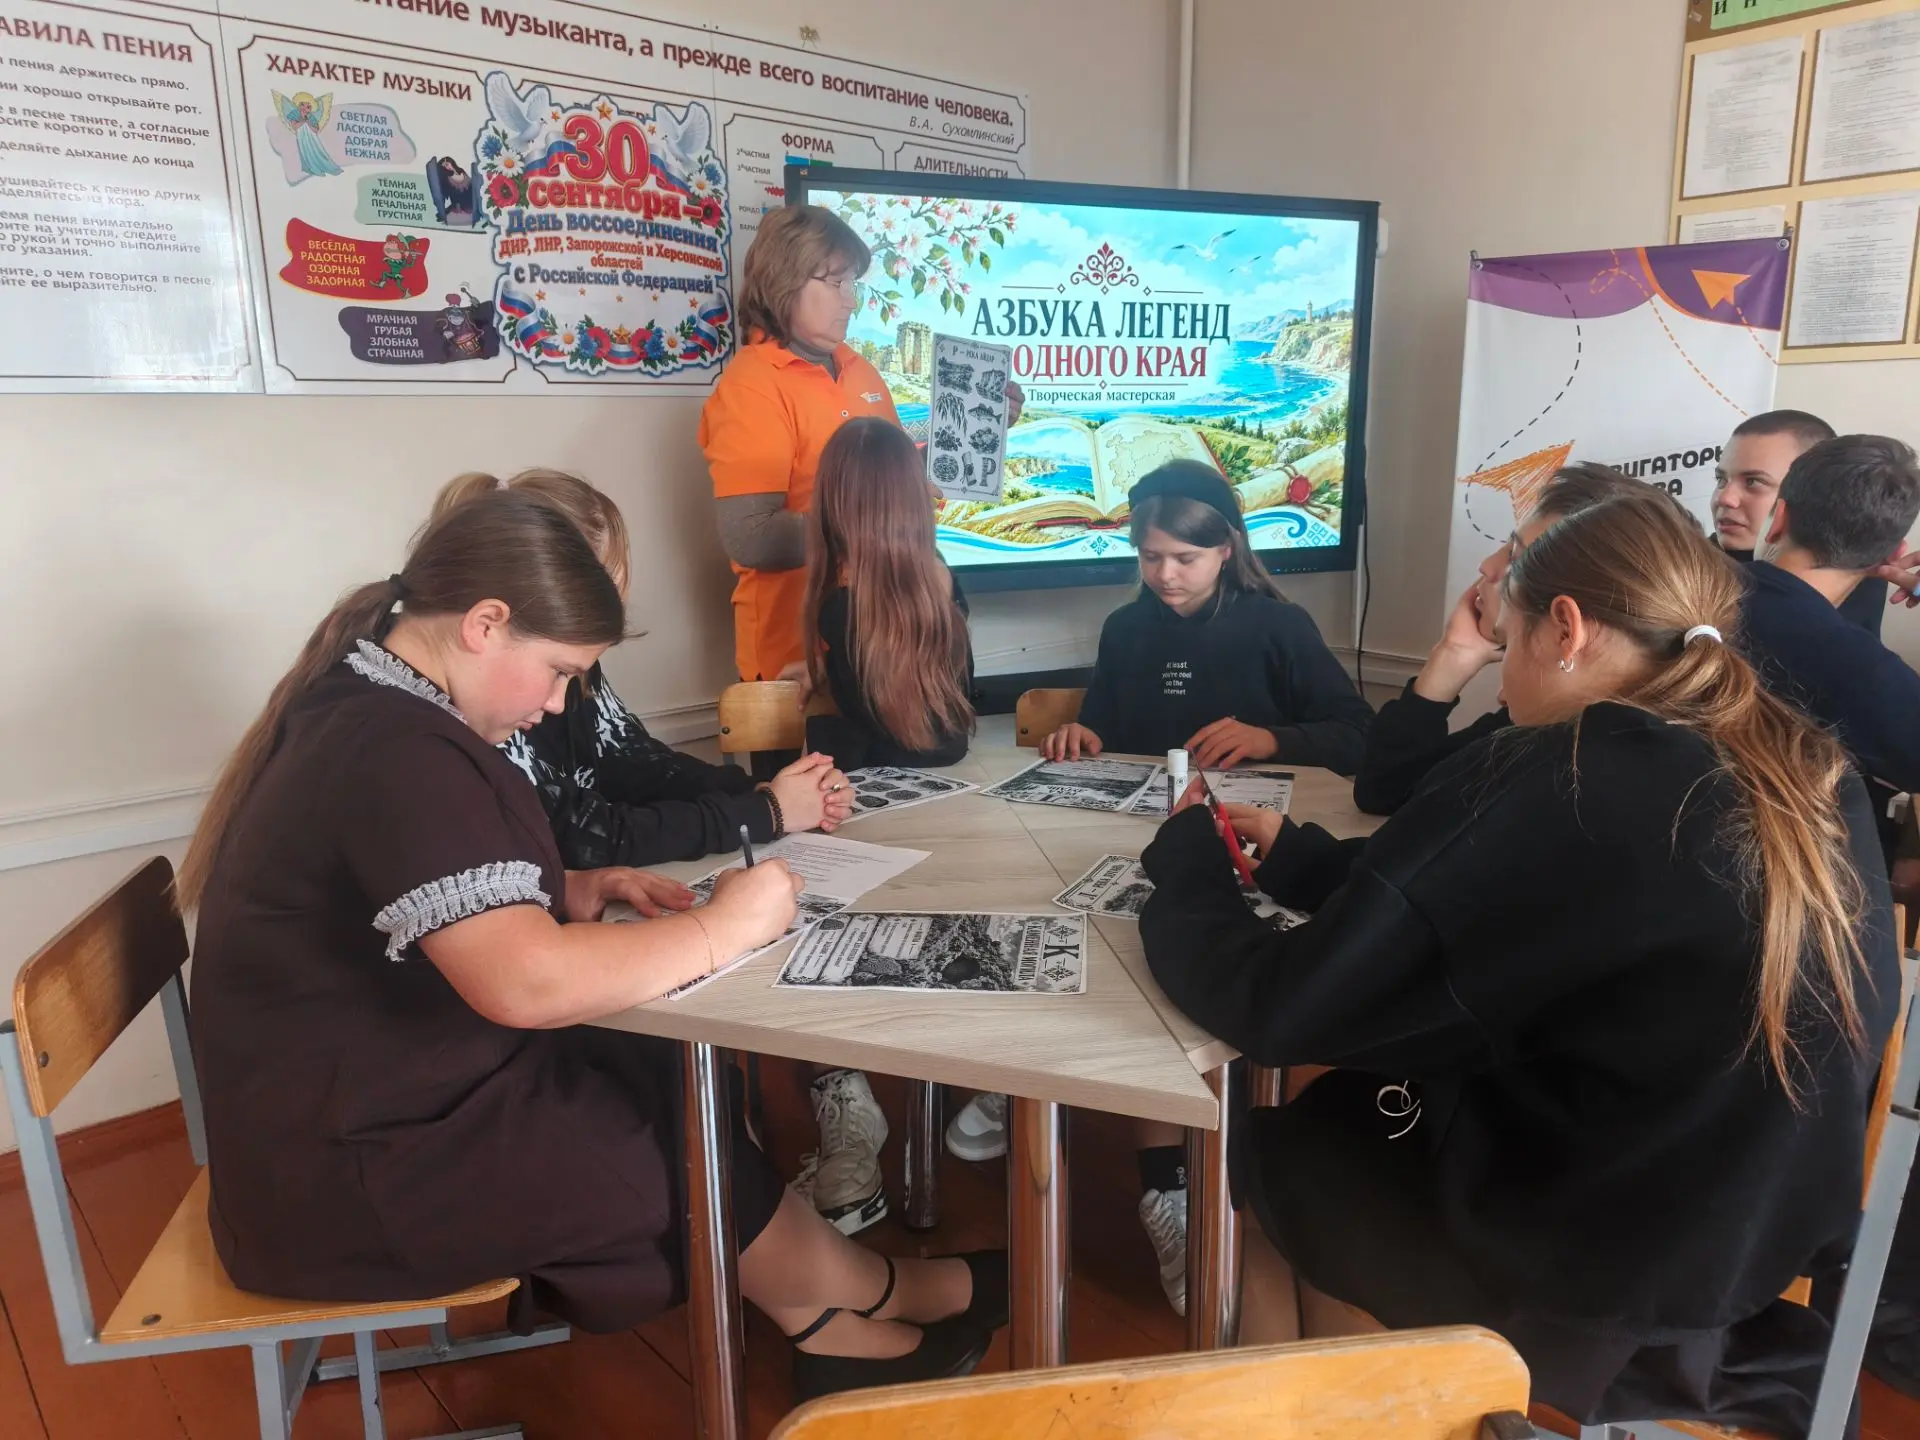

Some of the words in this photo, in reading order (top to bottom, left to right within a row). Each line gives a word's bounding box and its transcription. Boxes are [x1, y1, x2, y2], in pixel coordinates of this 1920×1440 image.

[103, 32, 193, 63] ПЕНИЯ
[9, 57, 55, 72] пения
[59, 65, 137, 83] держитесь
[141, 76, 189, 91] прямо.
[481, 6, 634, 56] музыканта,
[640, 38, 654, 57] а
[663, 43, 751, 77] прежде
[761, 60, 814, 86] всего
[822, 73, 929, 110] воспитание
[934, 97, 1014, 126] человека.
[266, 53, 375, 85] ХАРАКТЕР
[383, 72, 472, 101] МУЗЫКИ
[23, 83, 82, 100] хорошо
[87, 93, 170, 112] открывайте
[175, 103, 202, 115] рот.
[9, 105, 17, 115] в
[22, 107, 65, 121] песне
[70, 114, 123, 129] тяните,
[128, 121, 135, 129] а
[140, 123, 210, 138] согласные
[340, 110, 387, 125] СВЕТЛАЯ
[44, 122, 103, 137] коротко
[109, 129, 117, 138] и
[122, 131, 196, 146] отчетливо.
[336, 123, 393, 137] ЛАСКОВАЯ
[942, 122, 1015, 145] Сухомлинский
[345, 135, 388, 149] ДОБРАЯ
[781, 132, 835, 154] ФОРМА
[65, 148, 128, 162] дыхание
[132, 155, 149, 165] до
[155, 157, 194, 168] конца
[345, 148, 390, 161] НЕЖНАЯ
[564, 115, 650, 186] 30
[914, 156, 1009, 179] ДЛИТЕЛЬНОСТИ
[104, 186, 150, 197] пению
[155, 190, 200, 202] других
[372, 188, 425, 201] ЖАЛОБНАЯ
[108, 197, 144, 209] хора.
[371, 198, 427, 212] ПЕЧАЛЬНАЯ
[34, 213, 77, 225] пения
[83, 217, 173, 232] внимательно
[377, 209, 423, 221] ГРУСТНАЯ
[35, 224, 52, 233] на
[57, 225, 118, 239] учителя,
[123, 231, 177, 242] следите
[506, 209, 562, 236] День
[567, 212, 718, 253] воссоединения
[12, 233, 56, 244] рукой
[75, 238, 115, 248] точно
[121, 241, 201, 253] выполняйте
[21, 245, 93, 257] указания.
[301, 251, 366, 265] РАДОСТНАЯ
[499, 238, 530, 257] ДНР,
[534, 236, 563, 253] ЛНР,
[567, 237, 644, 255] Запорожской
[647, 245, 654, 256] и
[656, 244, 722, 272] Херсонской
[309, 264, 360, 275] ОЗОРНАЯ
[591, 257, 643, 270] областей
[44, 269, 52, 278] о
[57, 270, 84, 280] чем
[89, 272, 158, 284] говорится
[163, 275, 170, 284] в
[306, 275, 365, 287] ЗАДОРНАЯ
[514, 266, 525, 283] с
[529, 263, 619, 286] Российской
[621, 273, 713, 294] Федерацией
[31, 280, 48, 288] ее
[53, 280, 157, 293] выразительно.
[367, 314, 418, 325] МРАЧНАЯ
[972, 297, 1107, 337] АЗБУКА
[1115, 301, 1231, 346] ЛЕГЕНД
[374, 325, 412, 336] ГРУБАЯ
[370, 337, 419, 348] ЗЛОБНАЯ
[367, 348, 424, 359] СТРАШНАЯ
[1013, 344, 1128, 382] ОДНОГО
[1135, 346, 1207, 377] КРАЯ
[1028, 389, 1102, 405] Творческая
[1107, 391, 1176, 404] мастерская
